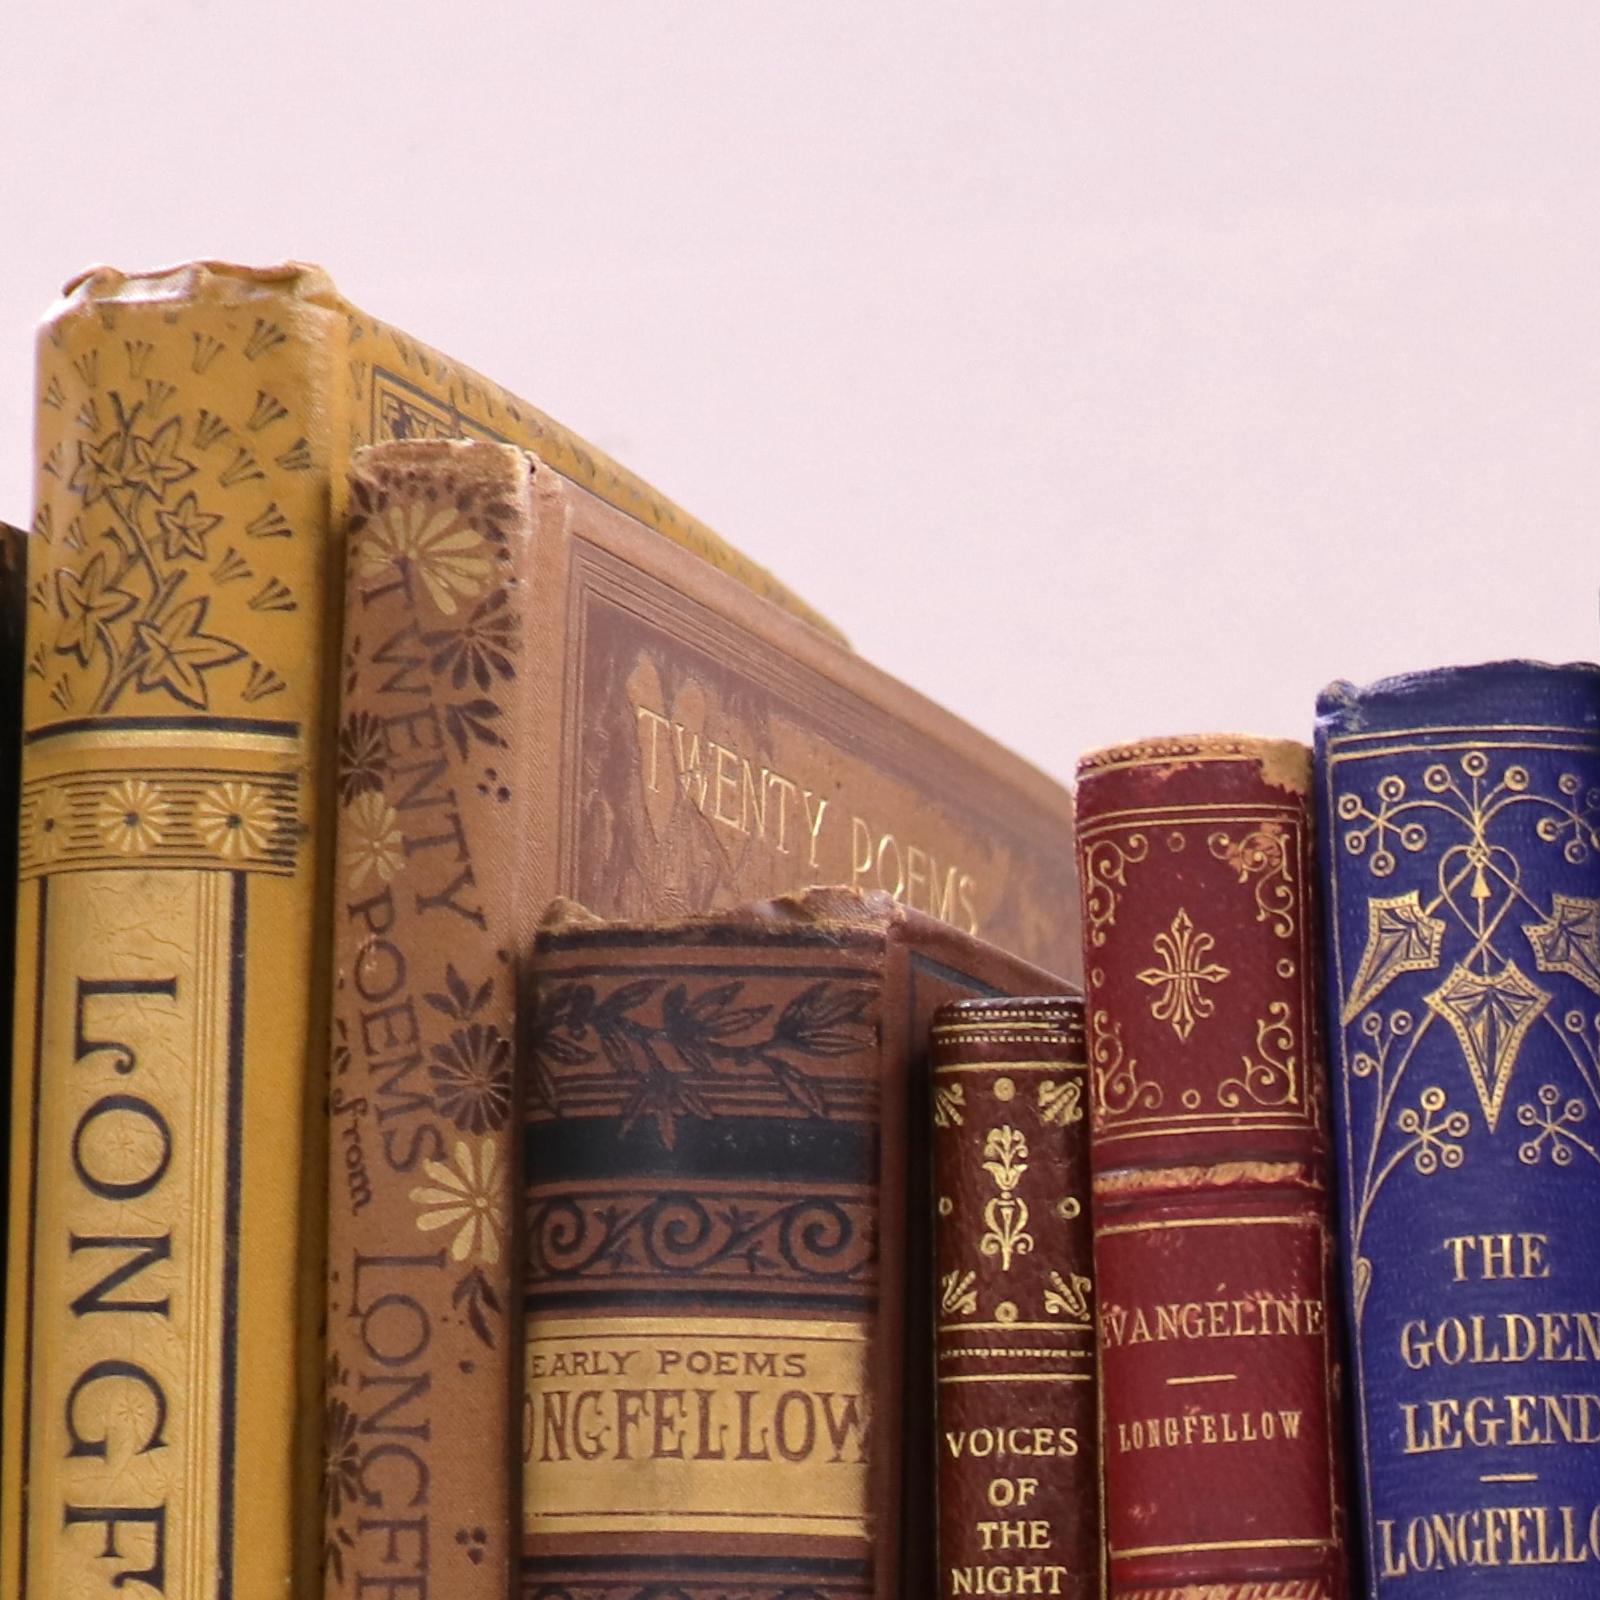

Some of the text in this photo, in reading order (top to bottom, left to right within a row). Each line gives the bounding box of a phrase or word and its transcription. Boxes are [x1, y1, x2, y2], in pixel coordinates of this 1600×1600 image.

[360, 556, 487, 932] TWENTY
[637, 705, 978, 936] TWENTY POEMS
[348, 887, 447, 1173] POEMS
[332, 1086, 372, 1216] from
[1444, 1233, 1552, 1283] THE
[1099, 1299, 1325, 1349] EVANGELINE
[533, 1349, 807, 1379] EARLY POEMS
[946, 1428, 1079, 1458] VOICES
[1118, 1410, 1303, 1454] LONGFELLOW
[988, 1478, 1039, 1507] OF
[977, 1520, 1052, 1551] THE
[951, 1564, 1068, 1598] NIGHT
